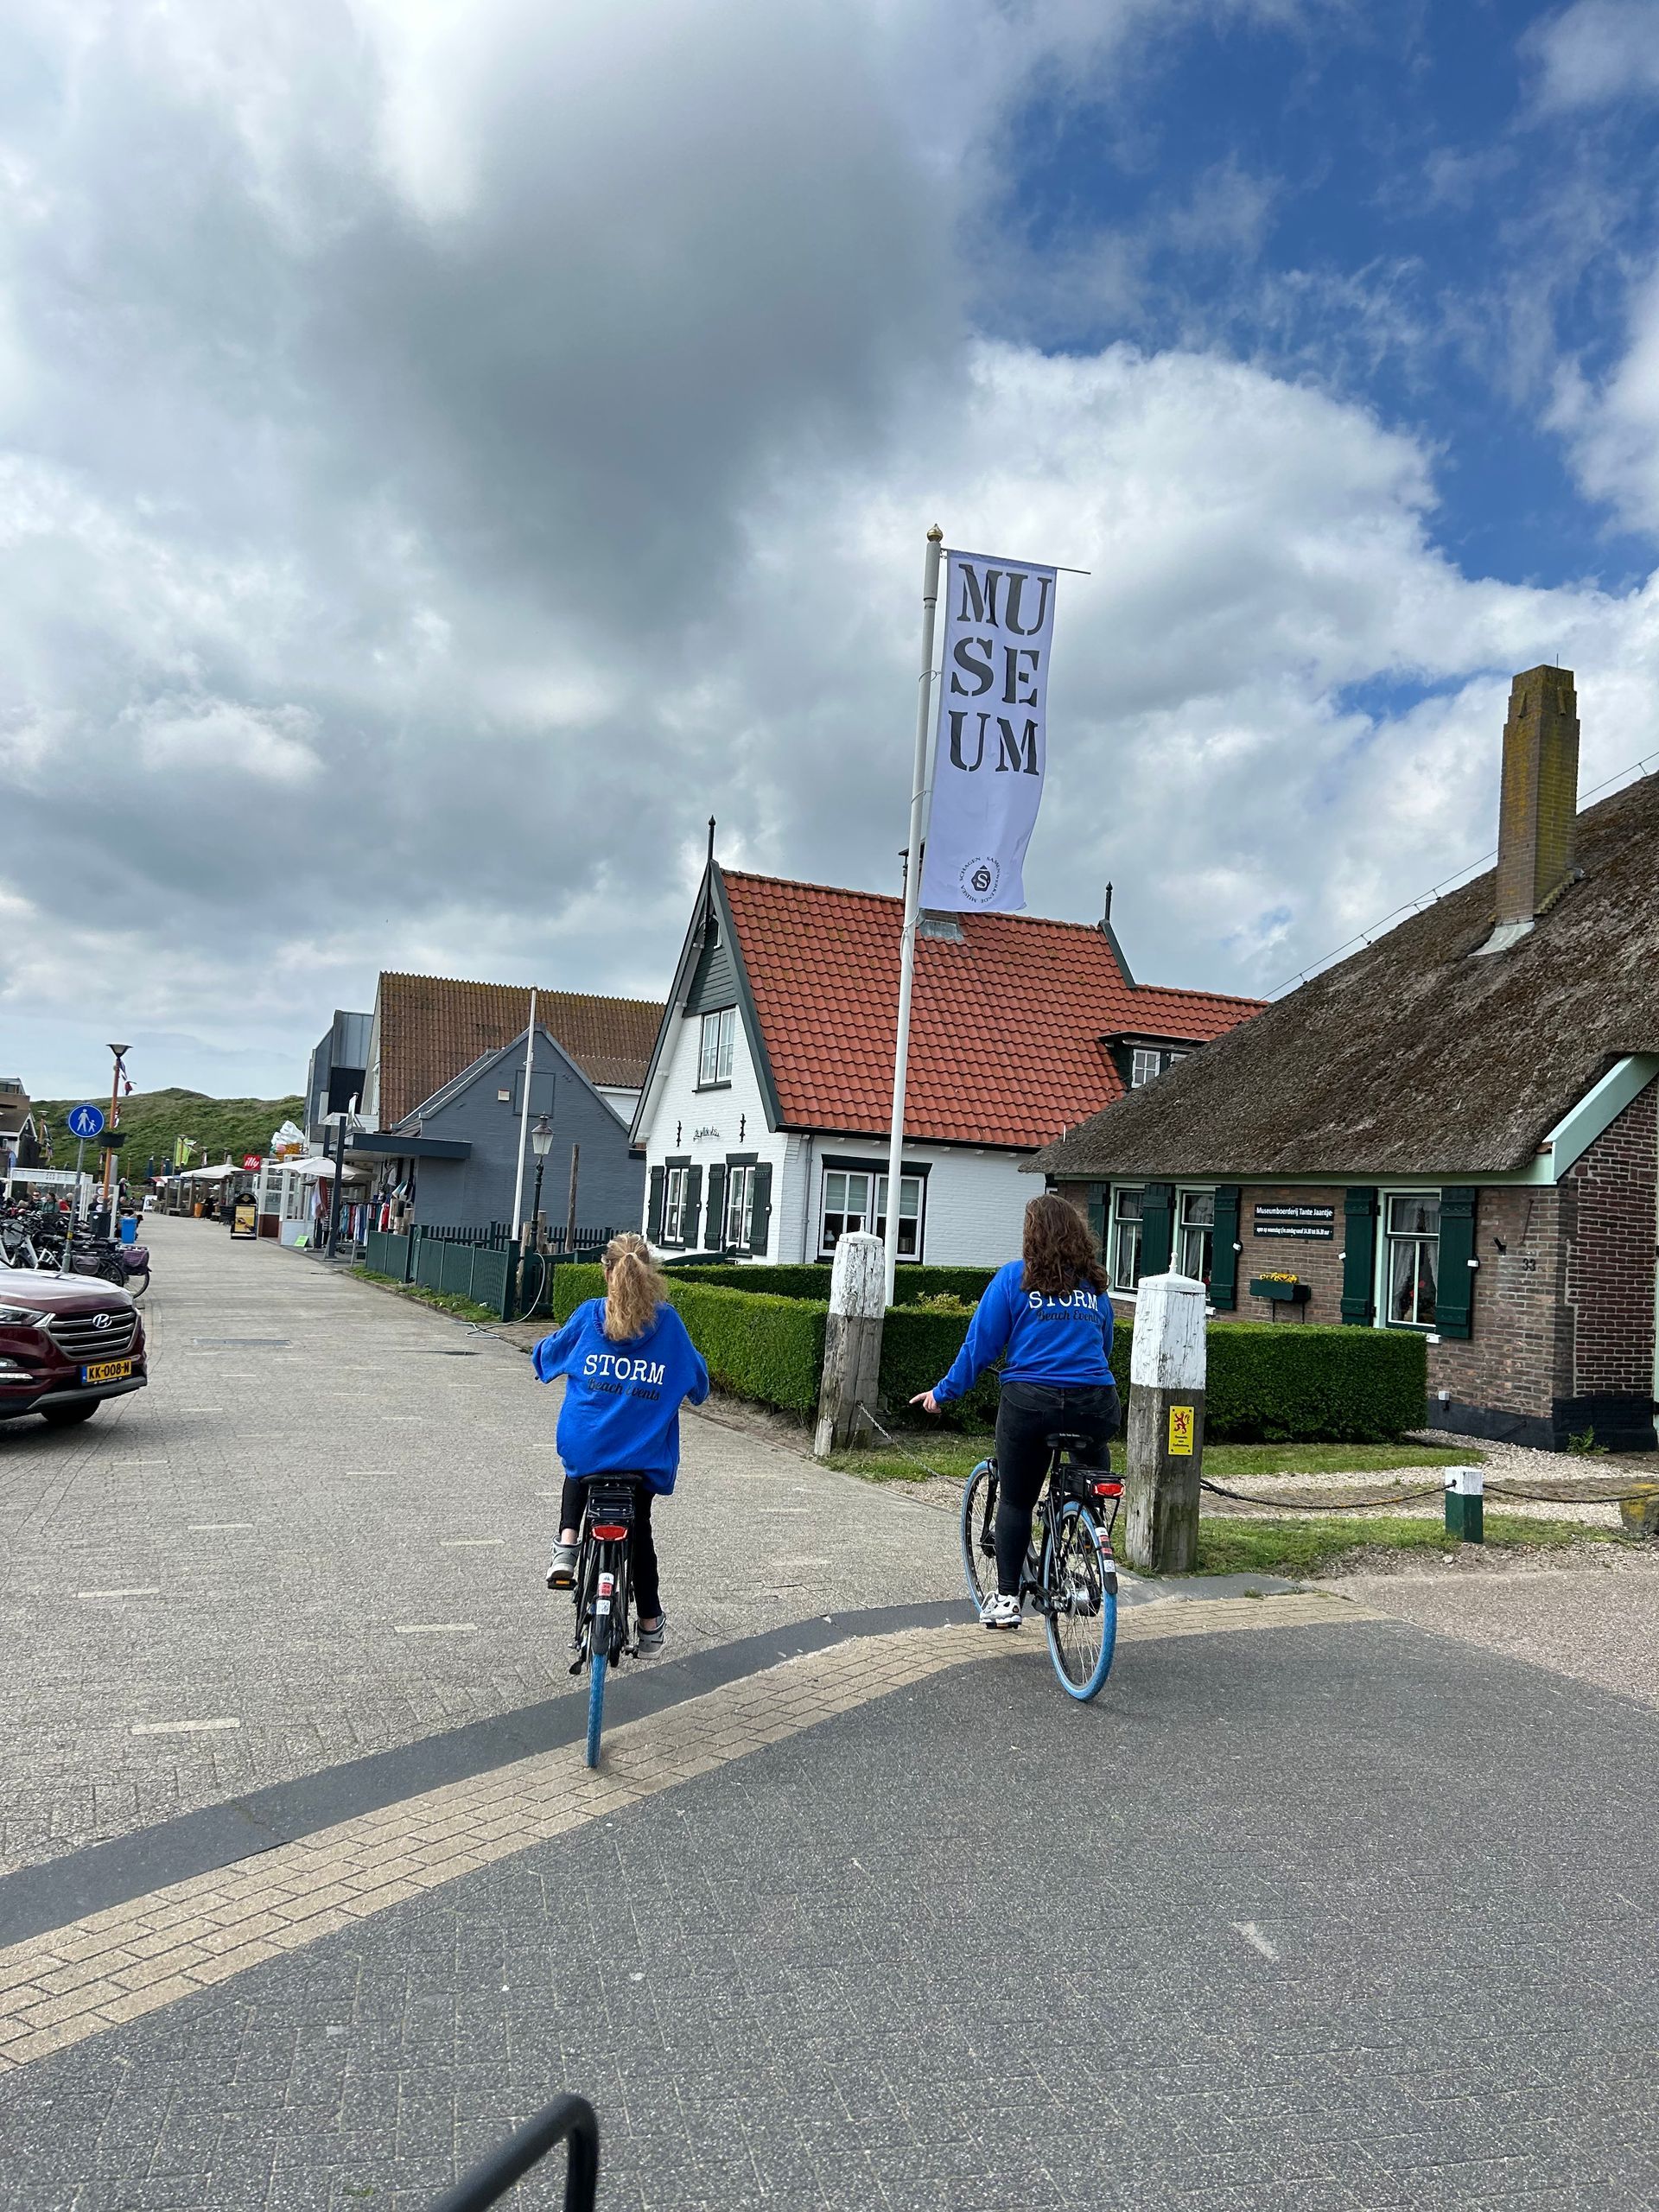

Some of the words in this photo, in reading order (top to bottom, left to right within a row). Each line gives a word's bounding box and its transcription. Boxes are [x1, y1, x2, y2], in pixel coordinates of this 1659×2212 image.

[959, 856, 982, 881] SCHAGEN
[245, 1157, 259, 1169] illy
[1256, 1206, 1299, 1217] Museumboerderij
[1313, 1209, 1332, 1218] Jaantje
[1522, 1257, 1536, 1272] 33
[1037, 1309, 1070, 1321] Beach
[583, 1354, 665, 1384] STORM
[588, 1377, 623, 1395] Beach
